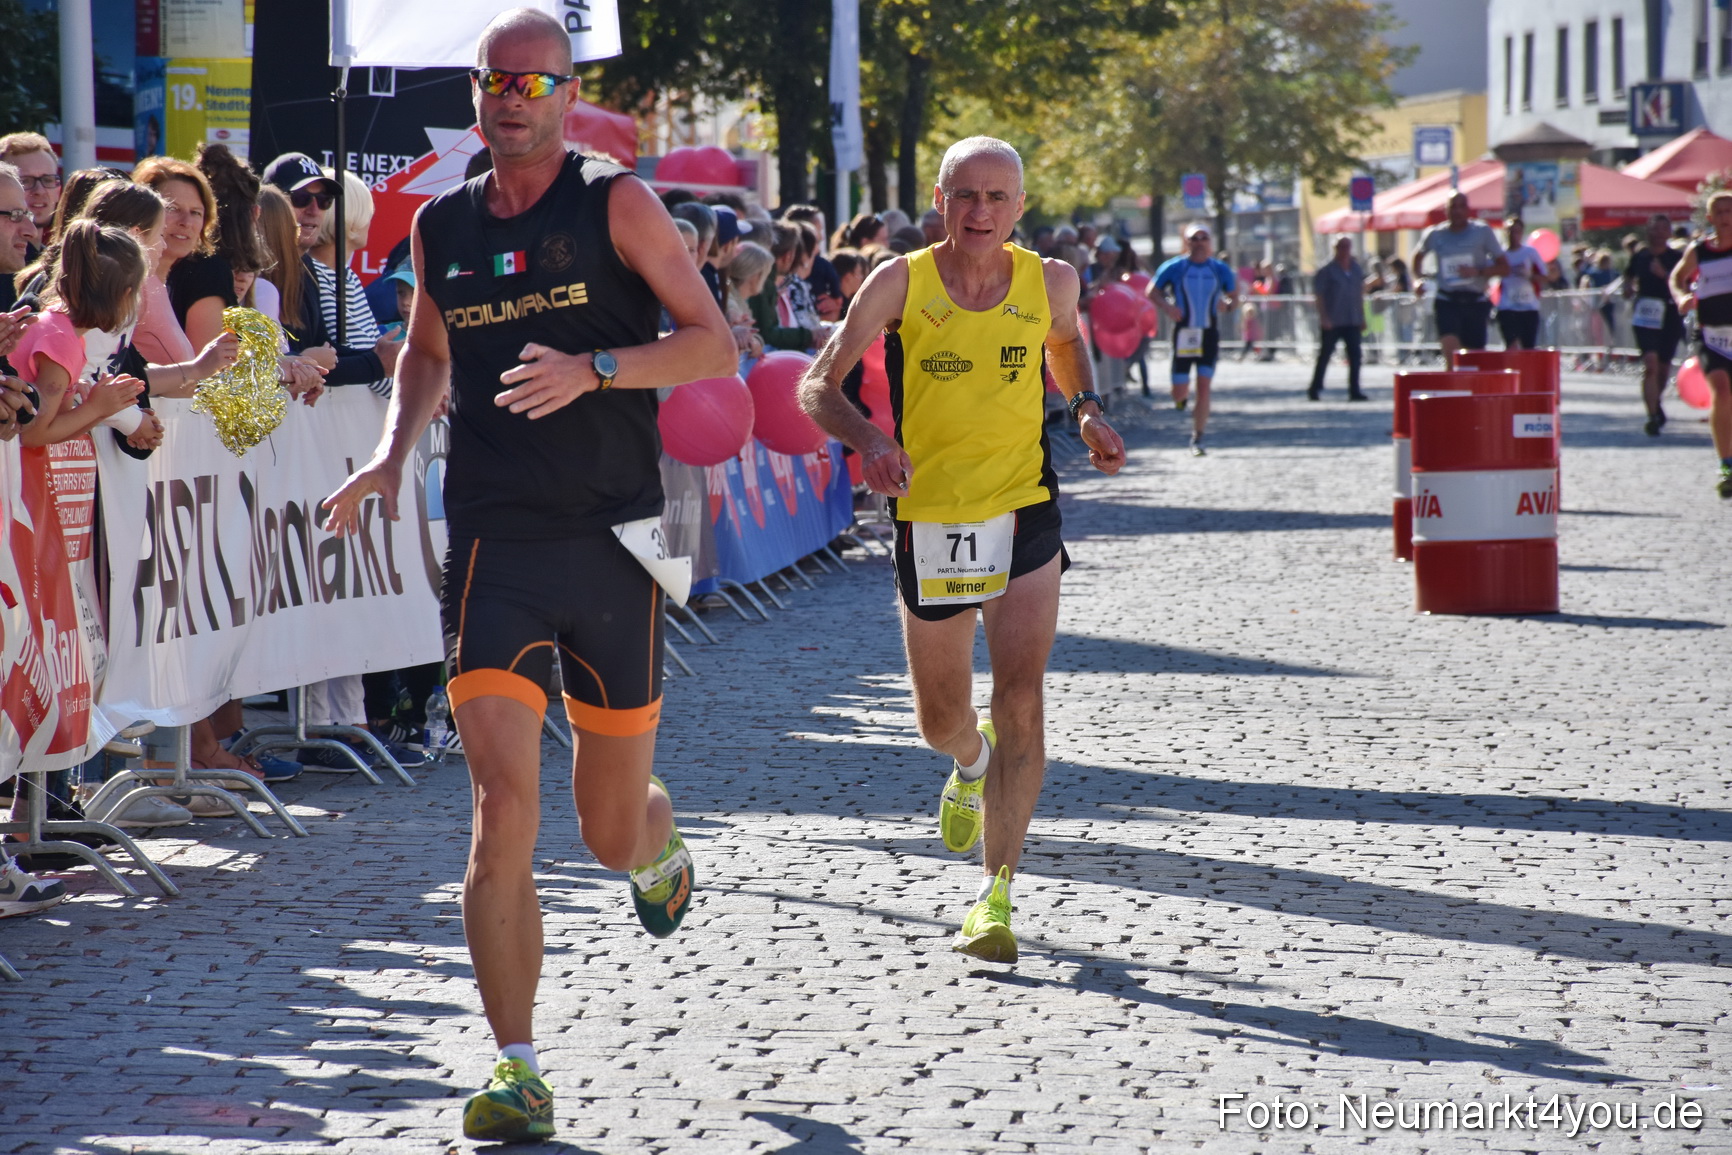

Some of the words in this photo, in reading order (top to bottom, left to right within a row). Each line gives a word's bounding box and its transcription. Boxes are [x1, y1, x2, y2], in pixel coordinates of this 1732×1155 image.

[170, 84, 203, 111] 19.
[321, 150, 358, 171] TE
[362, 153, 414, 174] NEXT
[444, 282, 589, 331] PODIUMRACE
[925, 361, 966, 371] FRANCESCO
[1001, 346, 1027, 363] MTP
[946, 532, 977, 562] 71
[132, 474, 246, 648] PARTL
[937, 567, 957, 575] PARTL
[945, 581, 987, 594] Werner
